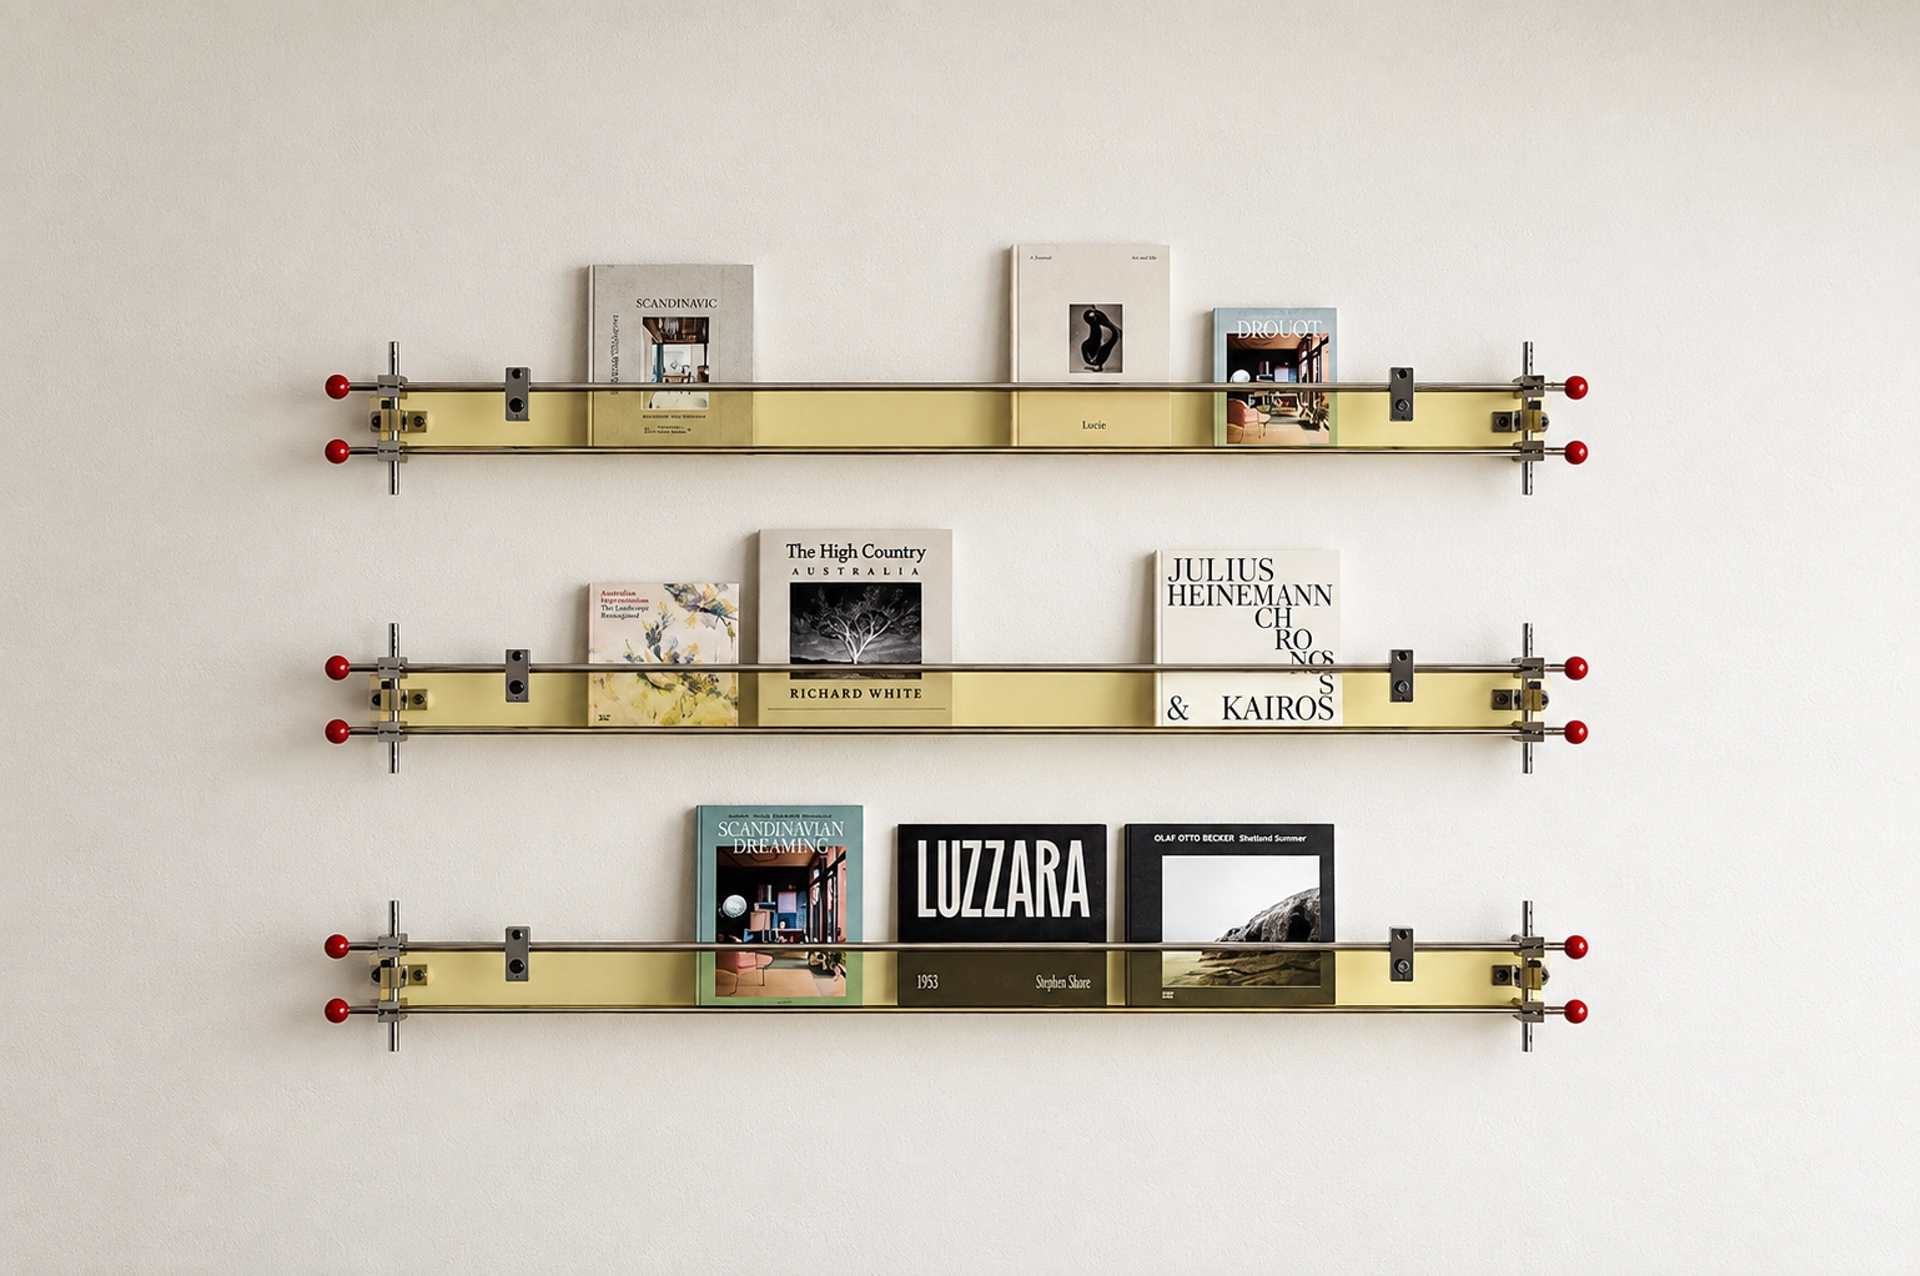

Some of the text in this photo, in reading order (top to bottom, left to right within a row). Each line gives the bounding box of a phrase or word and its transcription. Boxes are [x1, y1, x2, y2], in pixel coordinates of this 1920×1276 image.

[636, 298, 718, 309] SCANDINAVIC
[1237, 319, 1322, 339] DROUOT
[1082, 420, 1107, 431] Lucie
[786, 543, 927, 563] The High Country
[792, 567, 919, 576] AUSTRALIA
[1167, 557, 1274, 583] JULIUS
[1167, 584, 1333, 606] HEINEMANN
[1255, 607, 1292, 629] CH
[1275, 628, 1313, 651] RO
[790, 688, 922, 699] RICHARD WHITE
[1319, 674, 1334, 695] S
[1167, 695, 1334, 721] & KAIROS
[718, 821, 844, 837] SCANDINAVIAN
[1154, 834, 1307, 843] OLAF OTTO BECKER Shetland Summer
[733, 838, 829, 854] DREAMING
[917, 839, 1091, 918] LUZZARA
[916, 974, 939, 990] 1953
[1035, 974, 1091, 992] Stephen Shore
